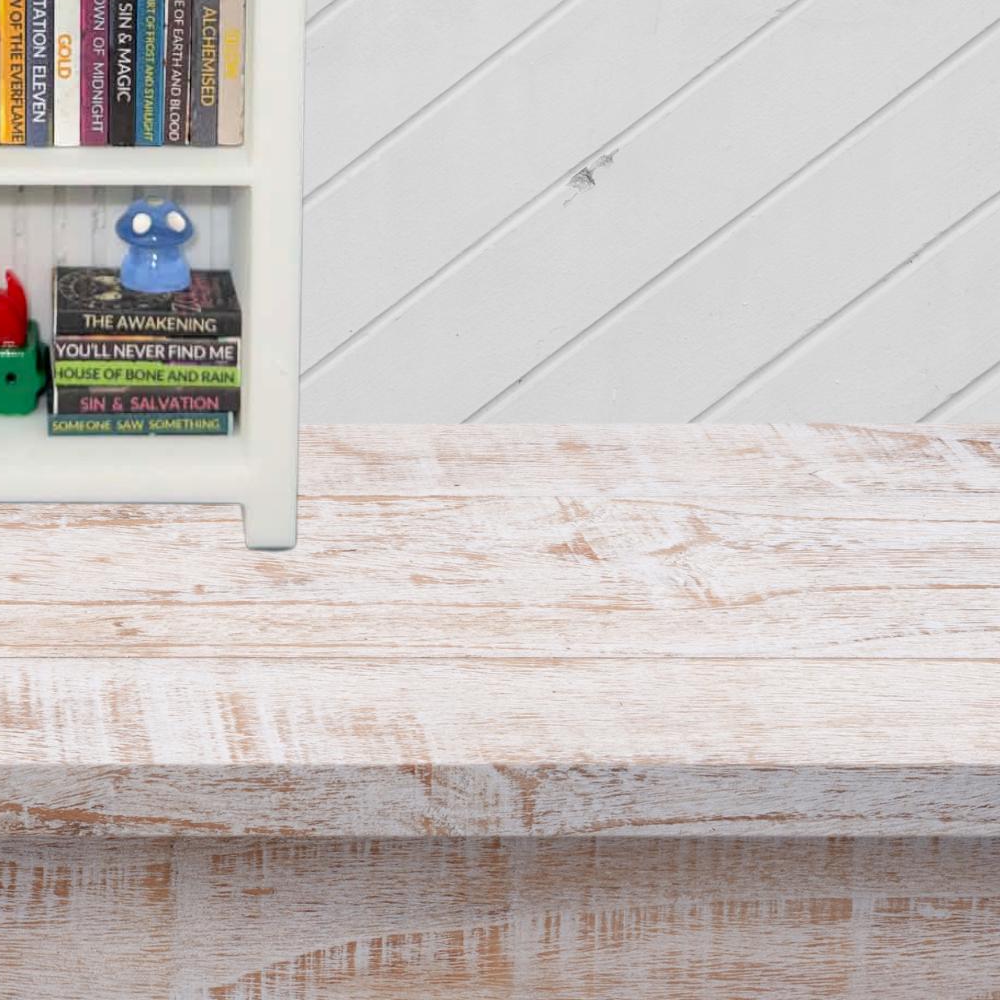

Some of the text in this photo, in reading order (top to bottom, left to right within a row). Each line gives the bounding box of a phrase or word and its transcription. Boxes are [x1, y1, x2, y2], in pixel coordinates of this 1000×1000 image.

[10, 11, 22, 30] OF
[146, 16, 156, 30] OF
[174, 9, 184, 26] OF
[10, 34, 22, 61] THE
[57, 34, 73, 80] GOLD
[93, 37, 105, 56] OF
[117, 2, 133, 103] SIN & MAGIC
[145, 31, 156, 62] FROST
[172, 28, 184, 66] EARTH
[201, 6, 216, 106] ALCHEMISED
[145, 65, 155, 87] AND
[171, 70, 183, 96] AND
[11, 63, 24, 142] EVERFLAME
[32, 65, 47, 123] ELEVEN
[91, 62, 105, 133] MIDNIGHT
[144, 88, 154, 142] STARLIGHT
[169, 99, 181, 141] BLOOD
[83, 314, 217, 333] THE AWAKENING
[55, 343, 234, 360] YOU'LL NEVER FIND ME
[103, 368, 235, 383] OF BONE AND RAIN
[80, 396, 219, 411] SIN & SALVATION
[52, 419, 220, 431] SOMEONE SAW SOMETHING
